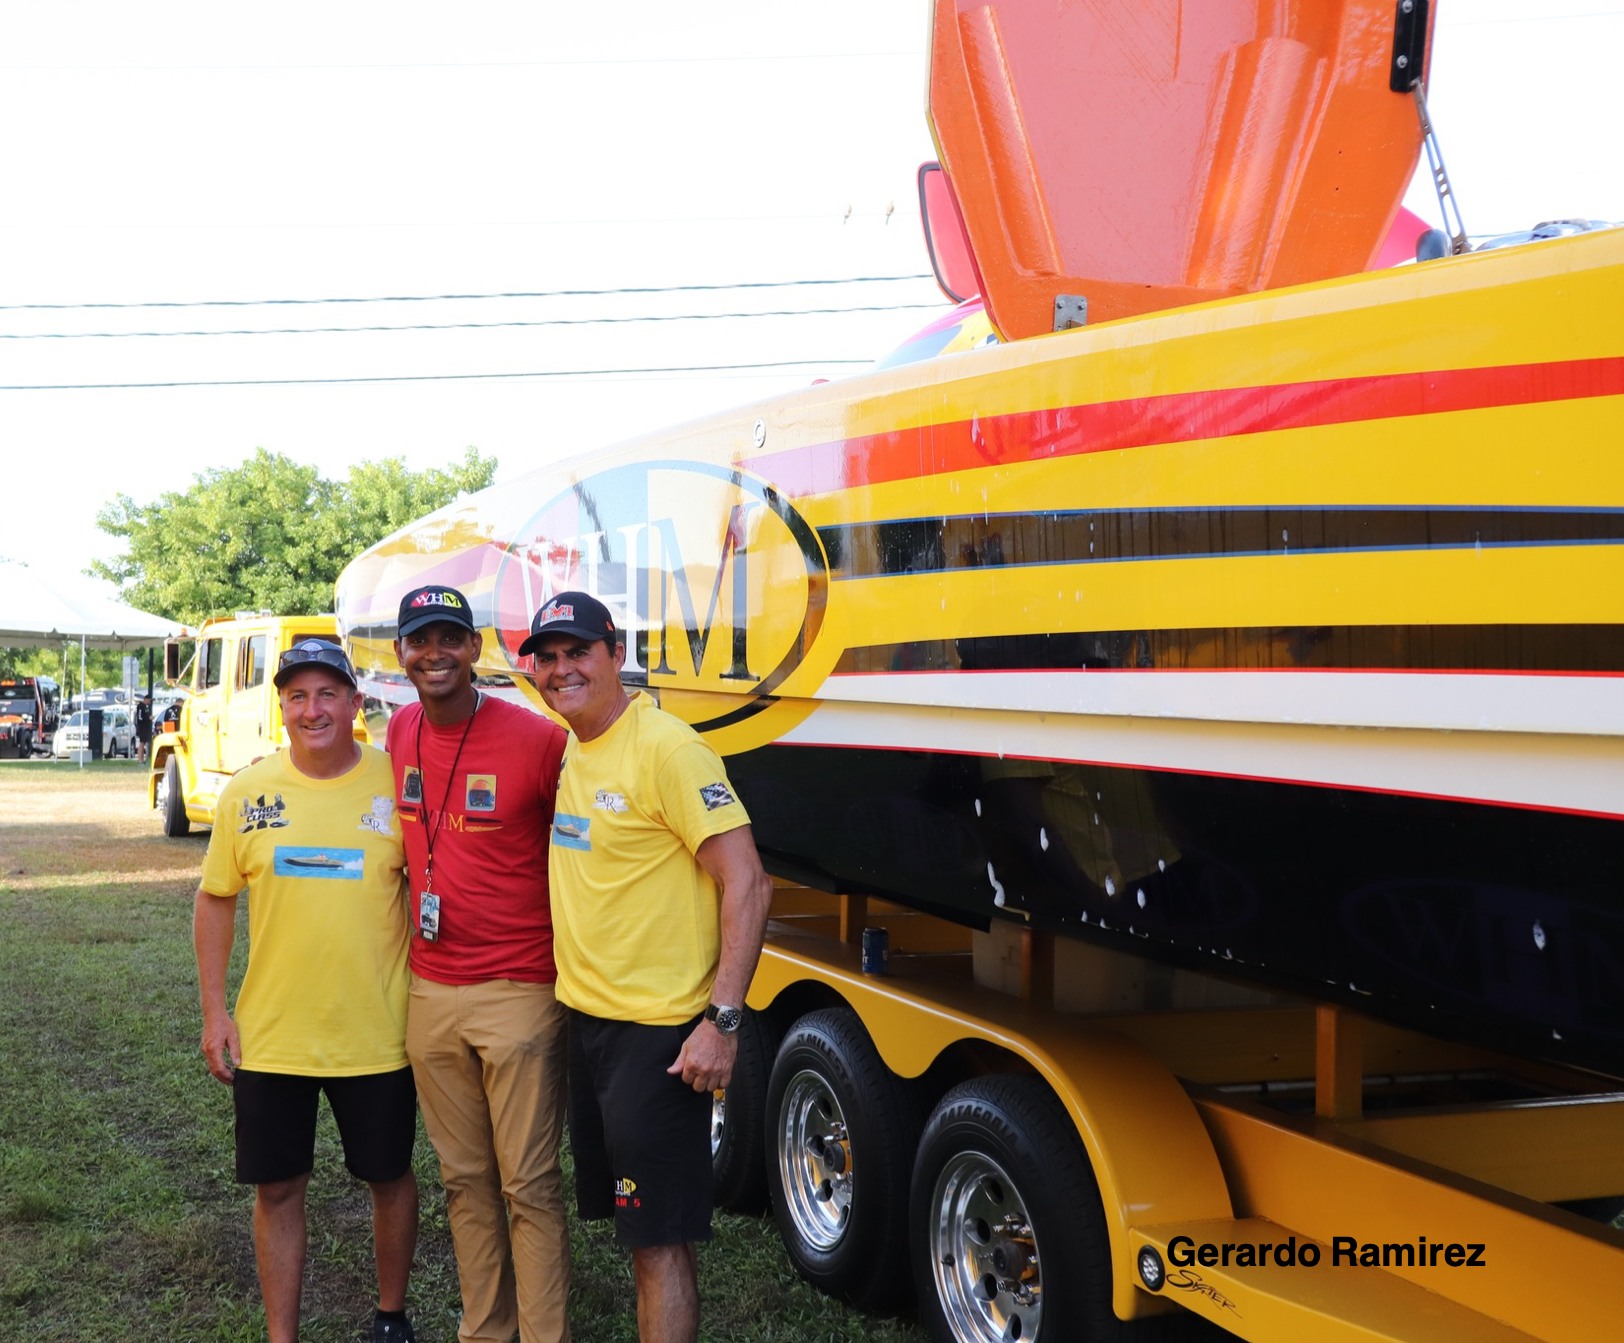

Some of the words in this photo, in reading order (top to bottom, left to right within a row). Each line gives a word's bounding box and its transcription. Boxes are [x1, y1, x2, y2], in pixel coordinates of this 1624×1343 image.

[516, 501, 762, 682] WHM
[415, 592, 459, 606] WHM
[247, 811, 281, 823] CLASS
[251, 806, 273, 815] PRO
[418, 808, 465, 833] WHM
